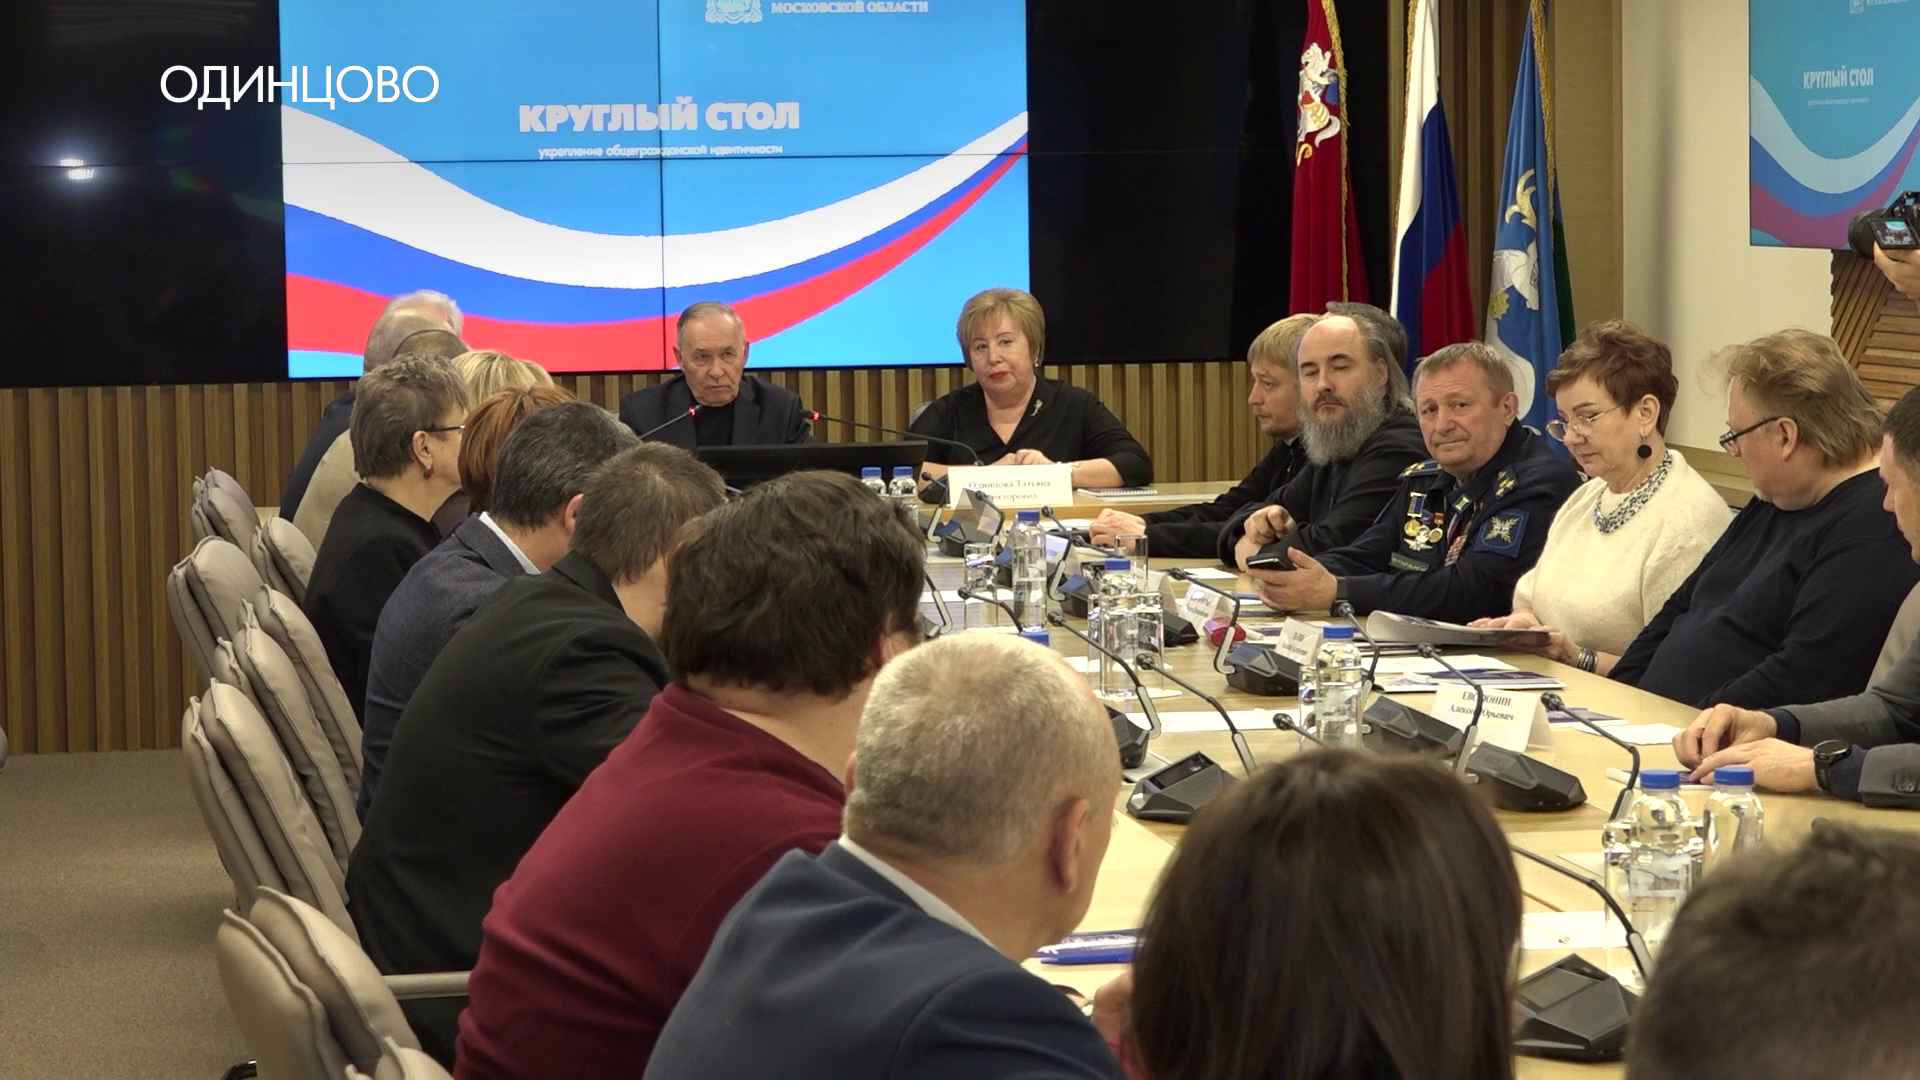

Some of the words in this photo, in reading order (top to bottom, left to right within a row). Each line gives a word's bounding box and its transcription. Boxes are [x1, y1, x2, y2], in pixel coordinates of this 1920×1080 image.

[771, 0, 865, 14] МОСКОВСКОЙ
[866, 1, 929, 13] ОБЛАСТИ
[1803, 64, 1848, 89] КРУГЛЫЙ
[1849, 68, 1874, 87] СТОЛ
[519, 96, 698, 132] КРУГЛЫЙ
[705, 102, 800, 131] СТОЛ
[538, 146, 604, 160] укрепление
[605, 143, 707, 158] общегражданской
[710, 144, 783, 156] идентичности
